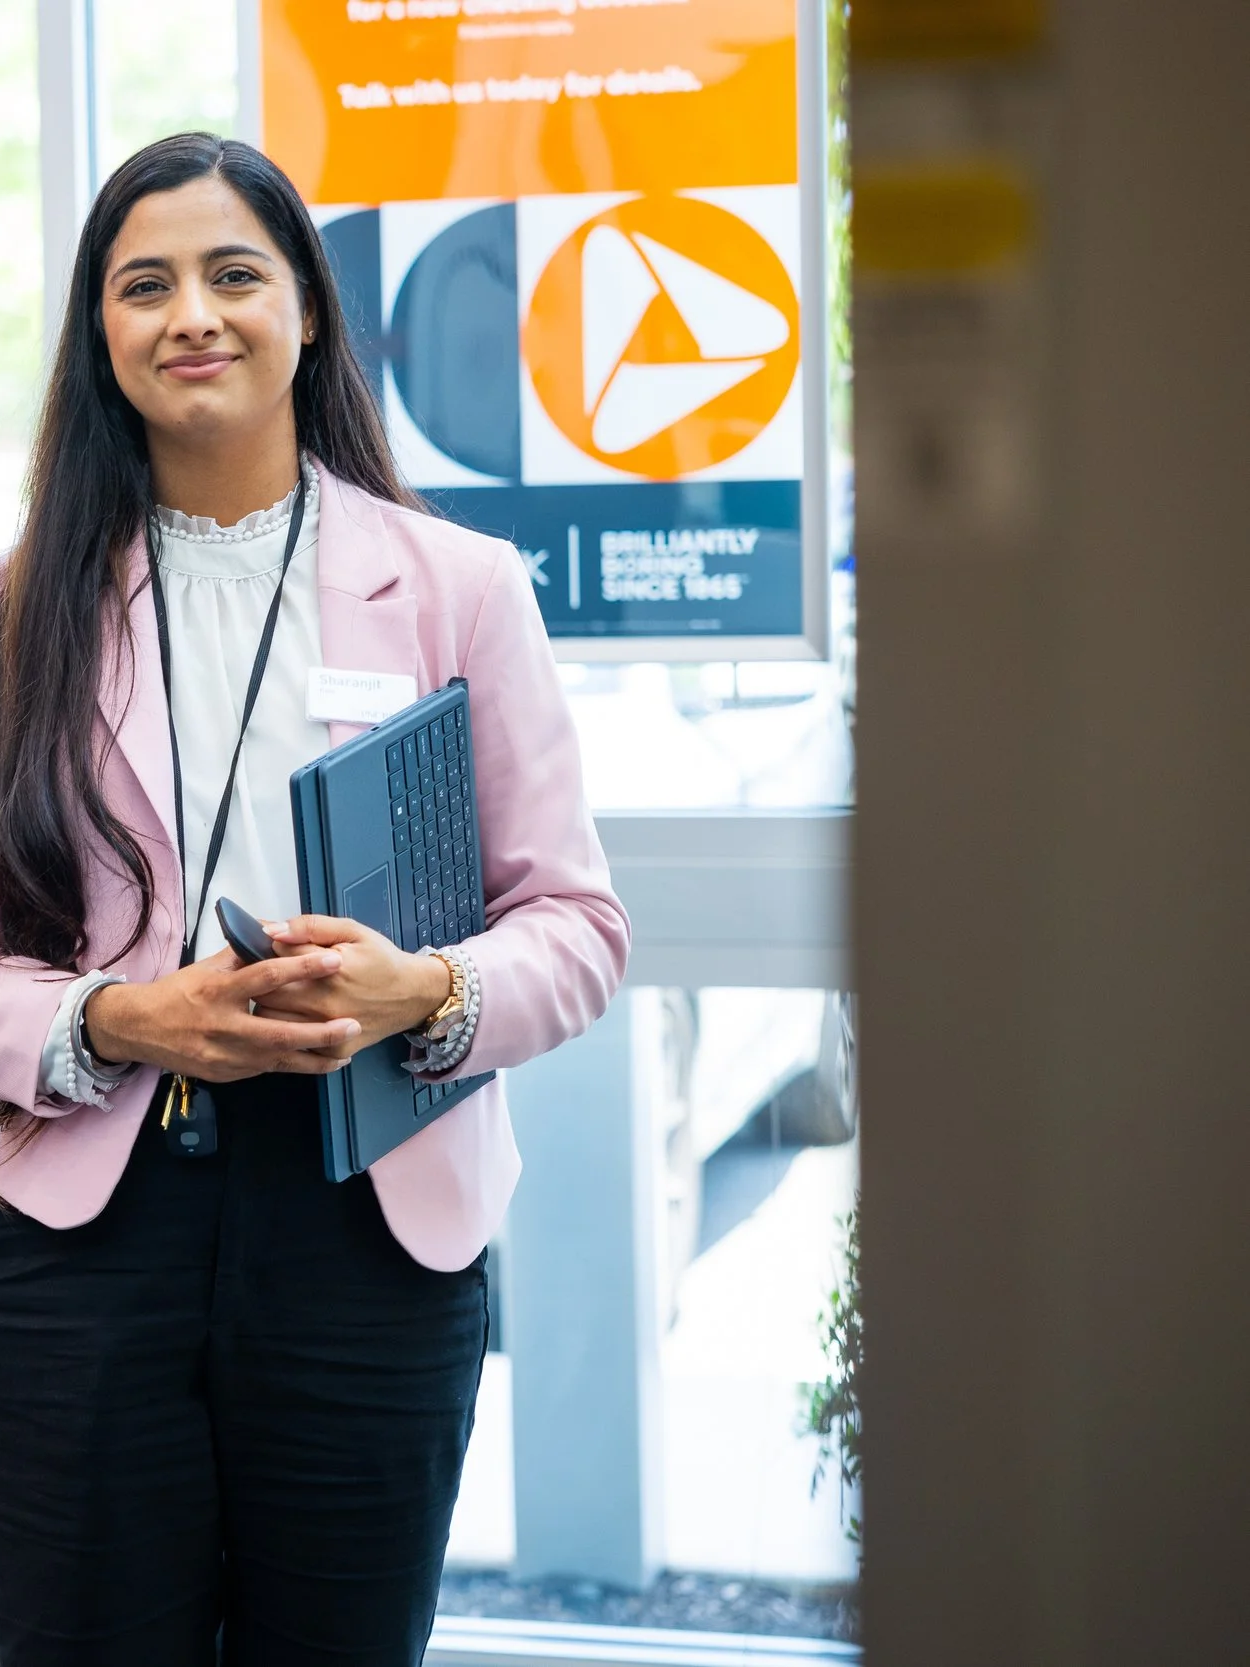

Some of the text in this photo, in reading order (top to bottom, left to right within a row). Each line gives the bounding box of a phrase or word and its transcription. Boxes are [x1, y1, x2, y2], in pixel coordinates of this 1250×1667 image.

[337, 83, 392, 109] Talk
[393, 78, 451, 107] with
[452, 81, 484, 104] us
[485, 73, 562, 104] today
[564, 70, 602, 98] for
[601, 529, 759, 556] BRILLIANTLY
[602, 577, 680, 601] SINCE
[319, 674, 381, 691] Sharanjit
